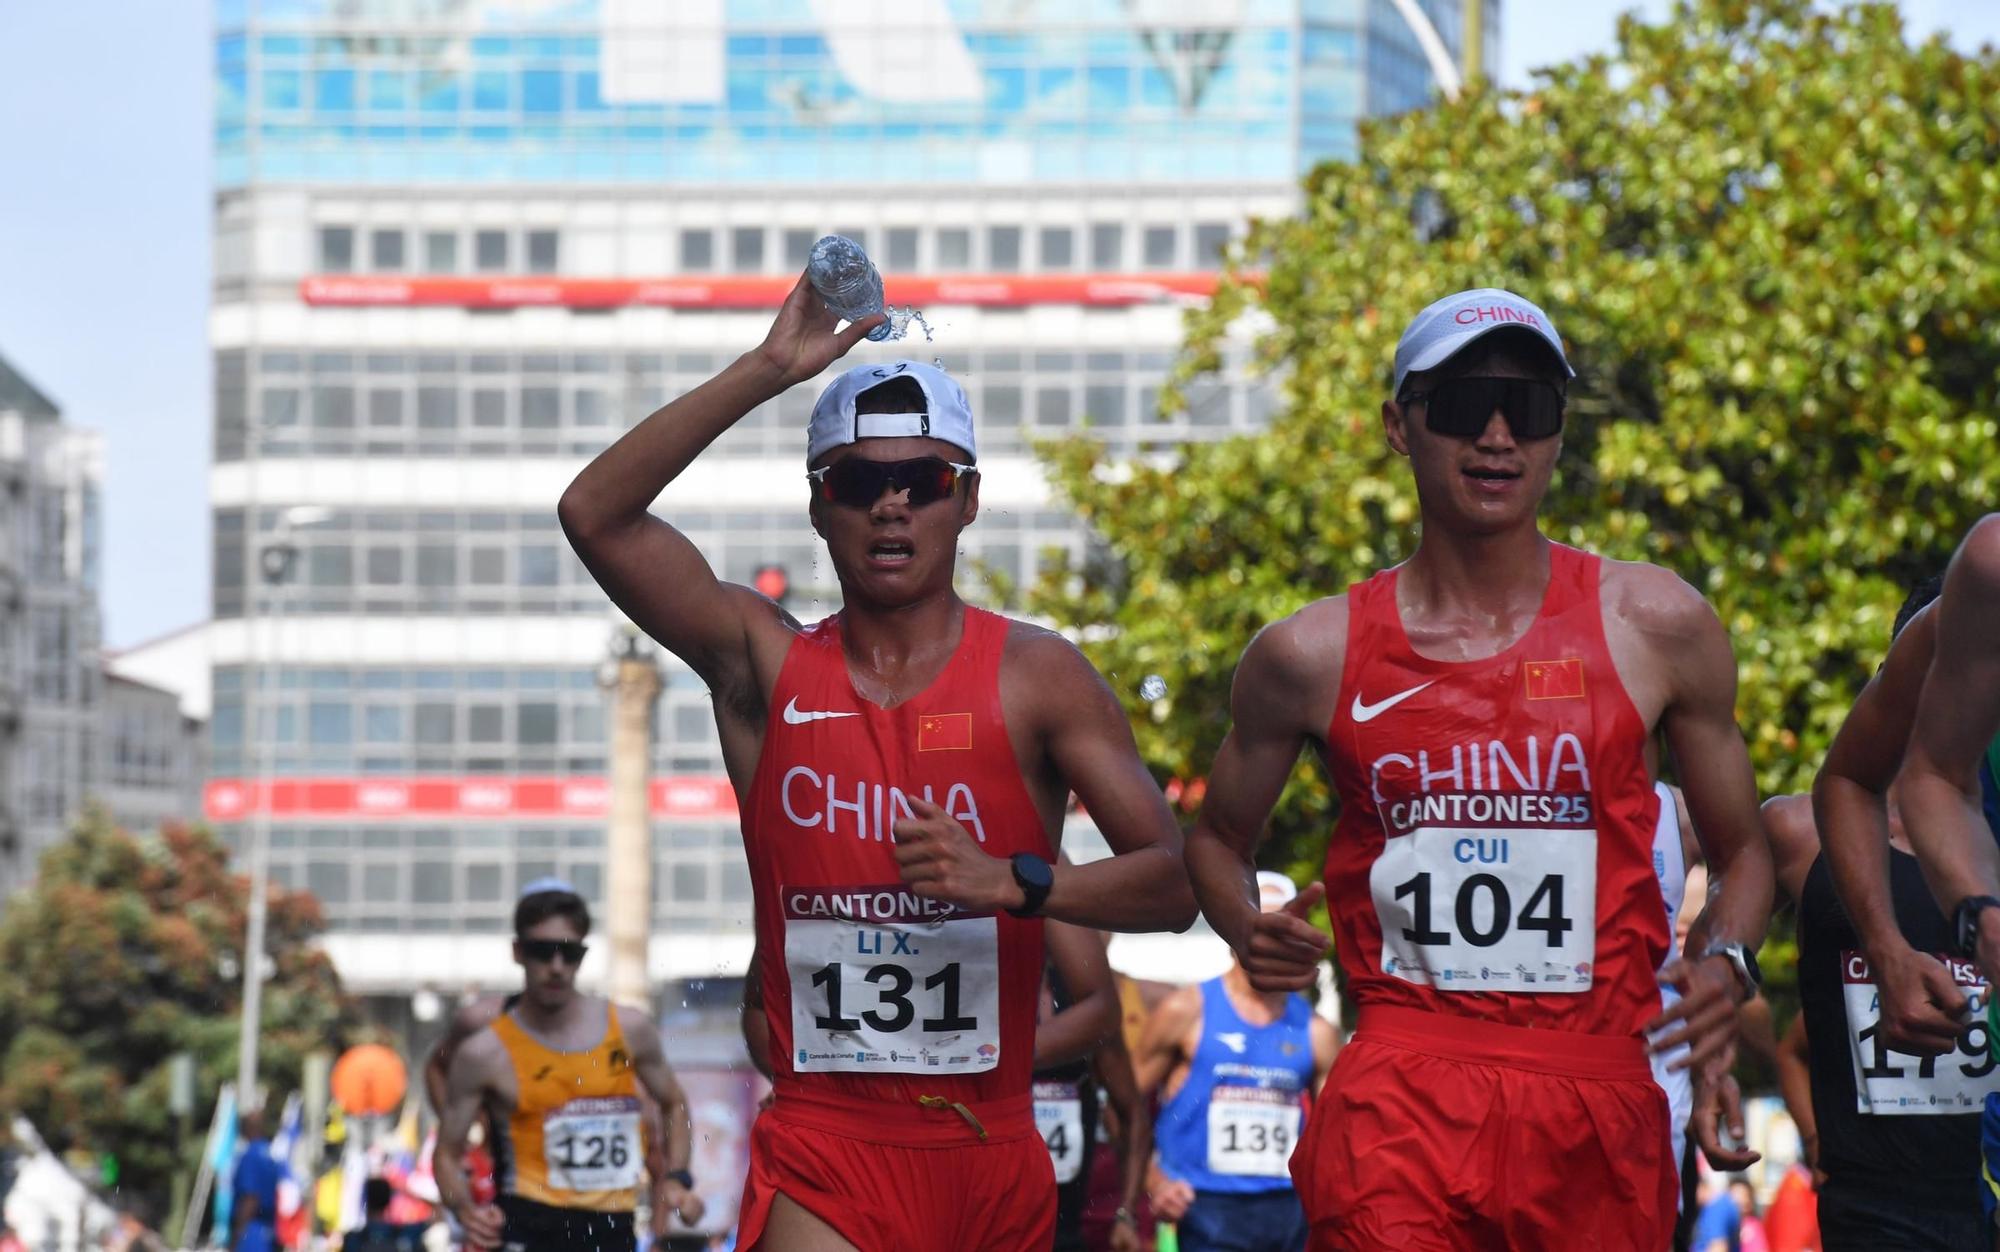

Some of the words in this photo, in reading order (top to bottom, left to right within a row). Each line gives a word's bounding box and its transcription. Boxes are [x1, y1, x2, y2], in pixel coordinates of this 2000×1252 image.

[1455, 306, 1541, 329] CHINA
[1371, 733, 1591, 804] CHINA
[1391, 795, 1589, 829] CANTONES25
[1454, 838, 1508, 863] CUI
[790, 892, 966, 918] CANTONES
[1395, 872, 1572, 948] 104
[858, 931, 881, 954] LI
[891, 932, 919, 955] X.
[812, 962, 977, 1033] 131
[556, 1135, 628, 1170] 126
[1221, 1123, 1289, 1155] 139
